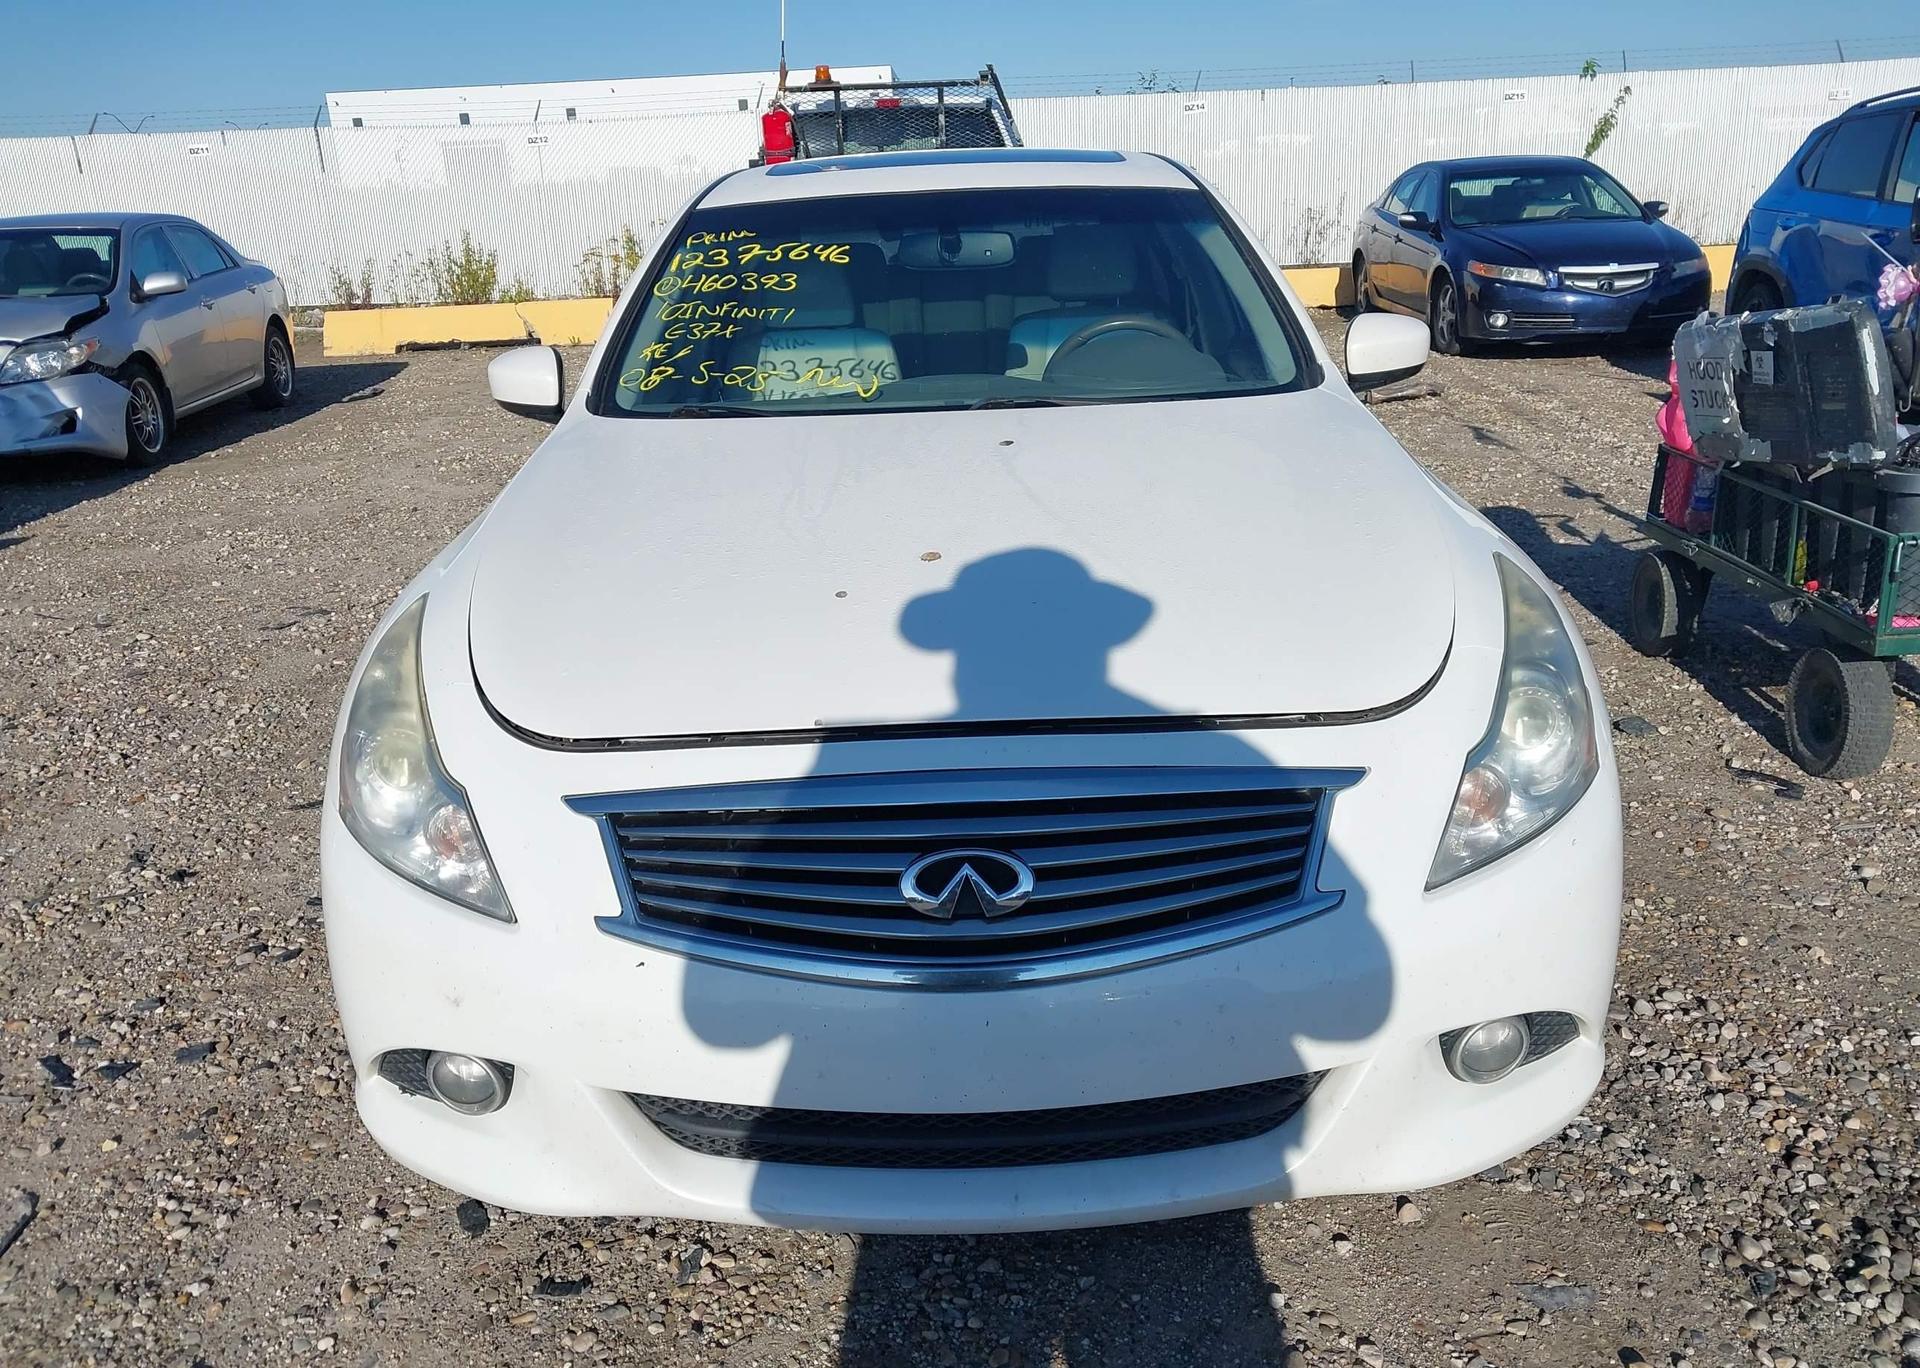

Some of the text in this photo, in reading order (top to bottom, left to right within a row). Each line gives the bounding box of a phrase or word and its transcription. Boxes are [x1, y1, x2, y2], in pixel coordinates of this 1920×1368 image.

[1504, 93, 1526, 101] DZ15
[527, 136, 549, 144] DZ12
[189, 147, 210, 155] DZ11
[669, 241, 851, 273] 12375646
[1687, 361, 1723, 380] HOOD
